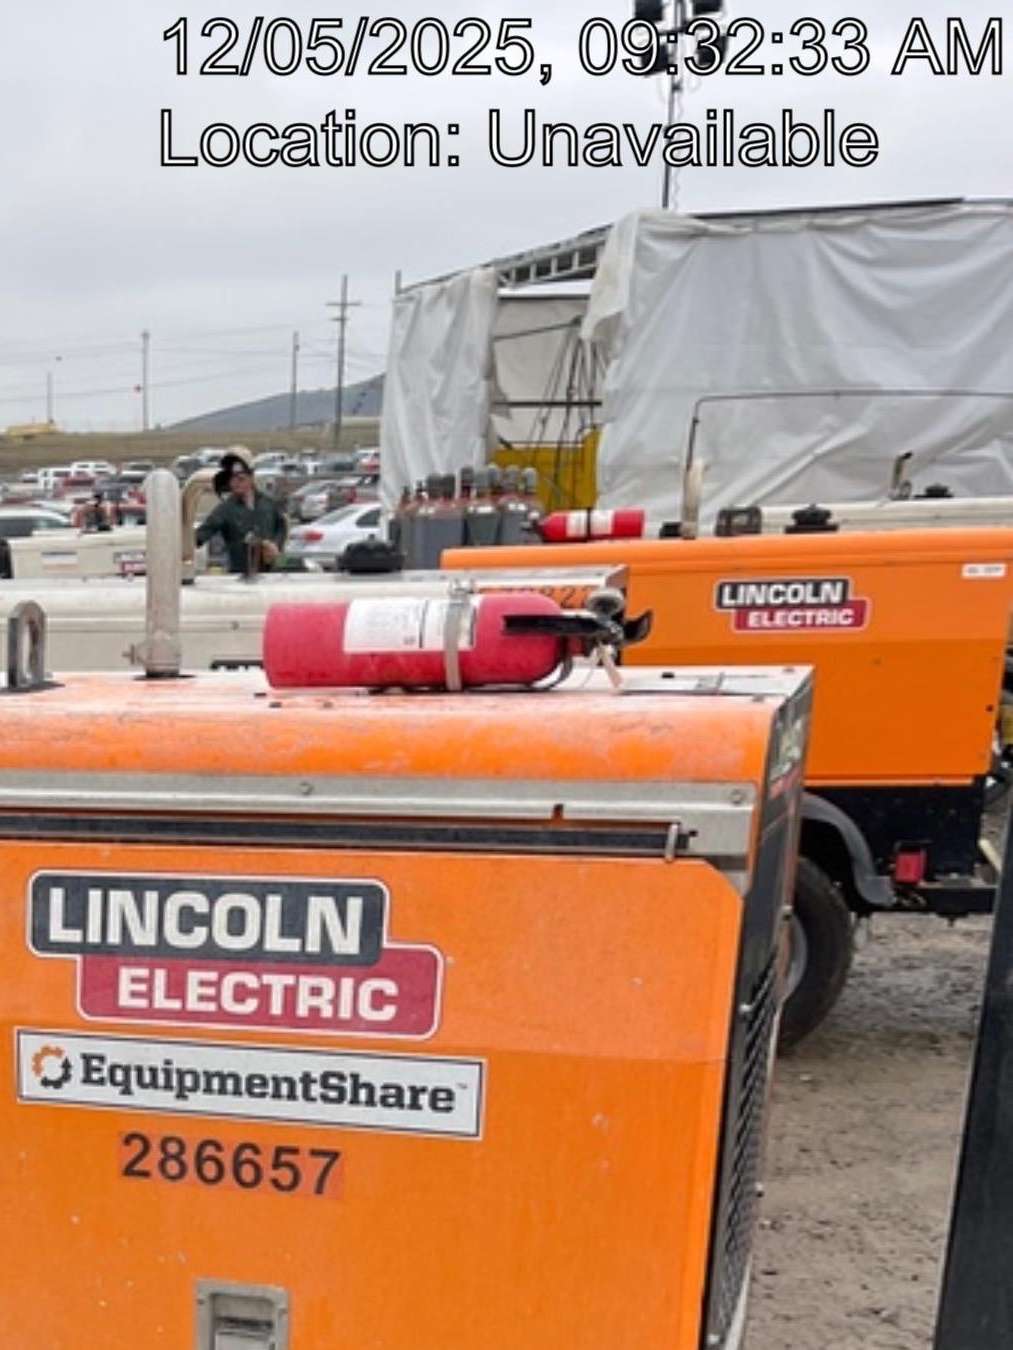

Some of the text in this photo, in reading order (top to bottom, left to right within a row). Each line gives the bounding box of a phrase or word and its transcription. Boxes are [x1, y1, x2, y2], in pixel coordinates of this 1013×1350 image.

[721, 582, 844, 606] LINCOLN
[748, 609, 854, 628] ELECTRIC
[48, 887, 363, 955] LINCOLN
[117, 967, 398, 1022] ELECTRIC
[80, 1052, 456, 1114] EquipmentShare
[121, 1132, 341, 1195] 286657
